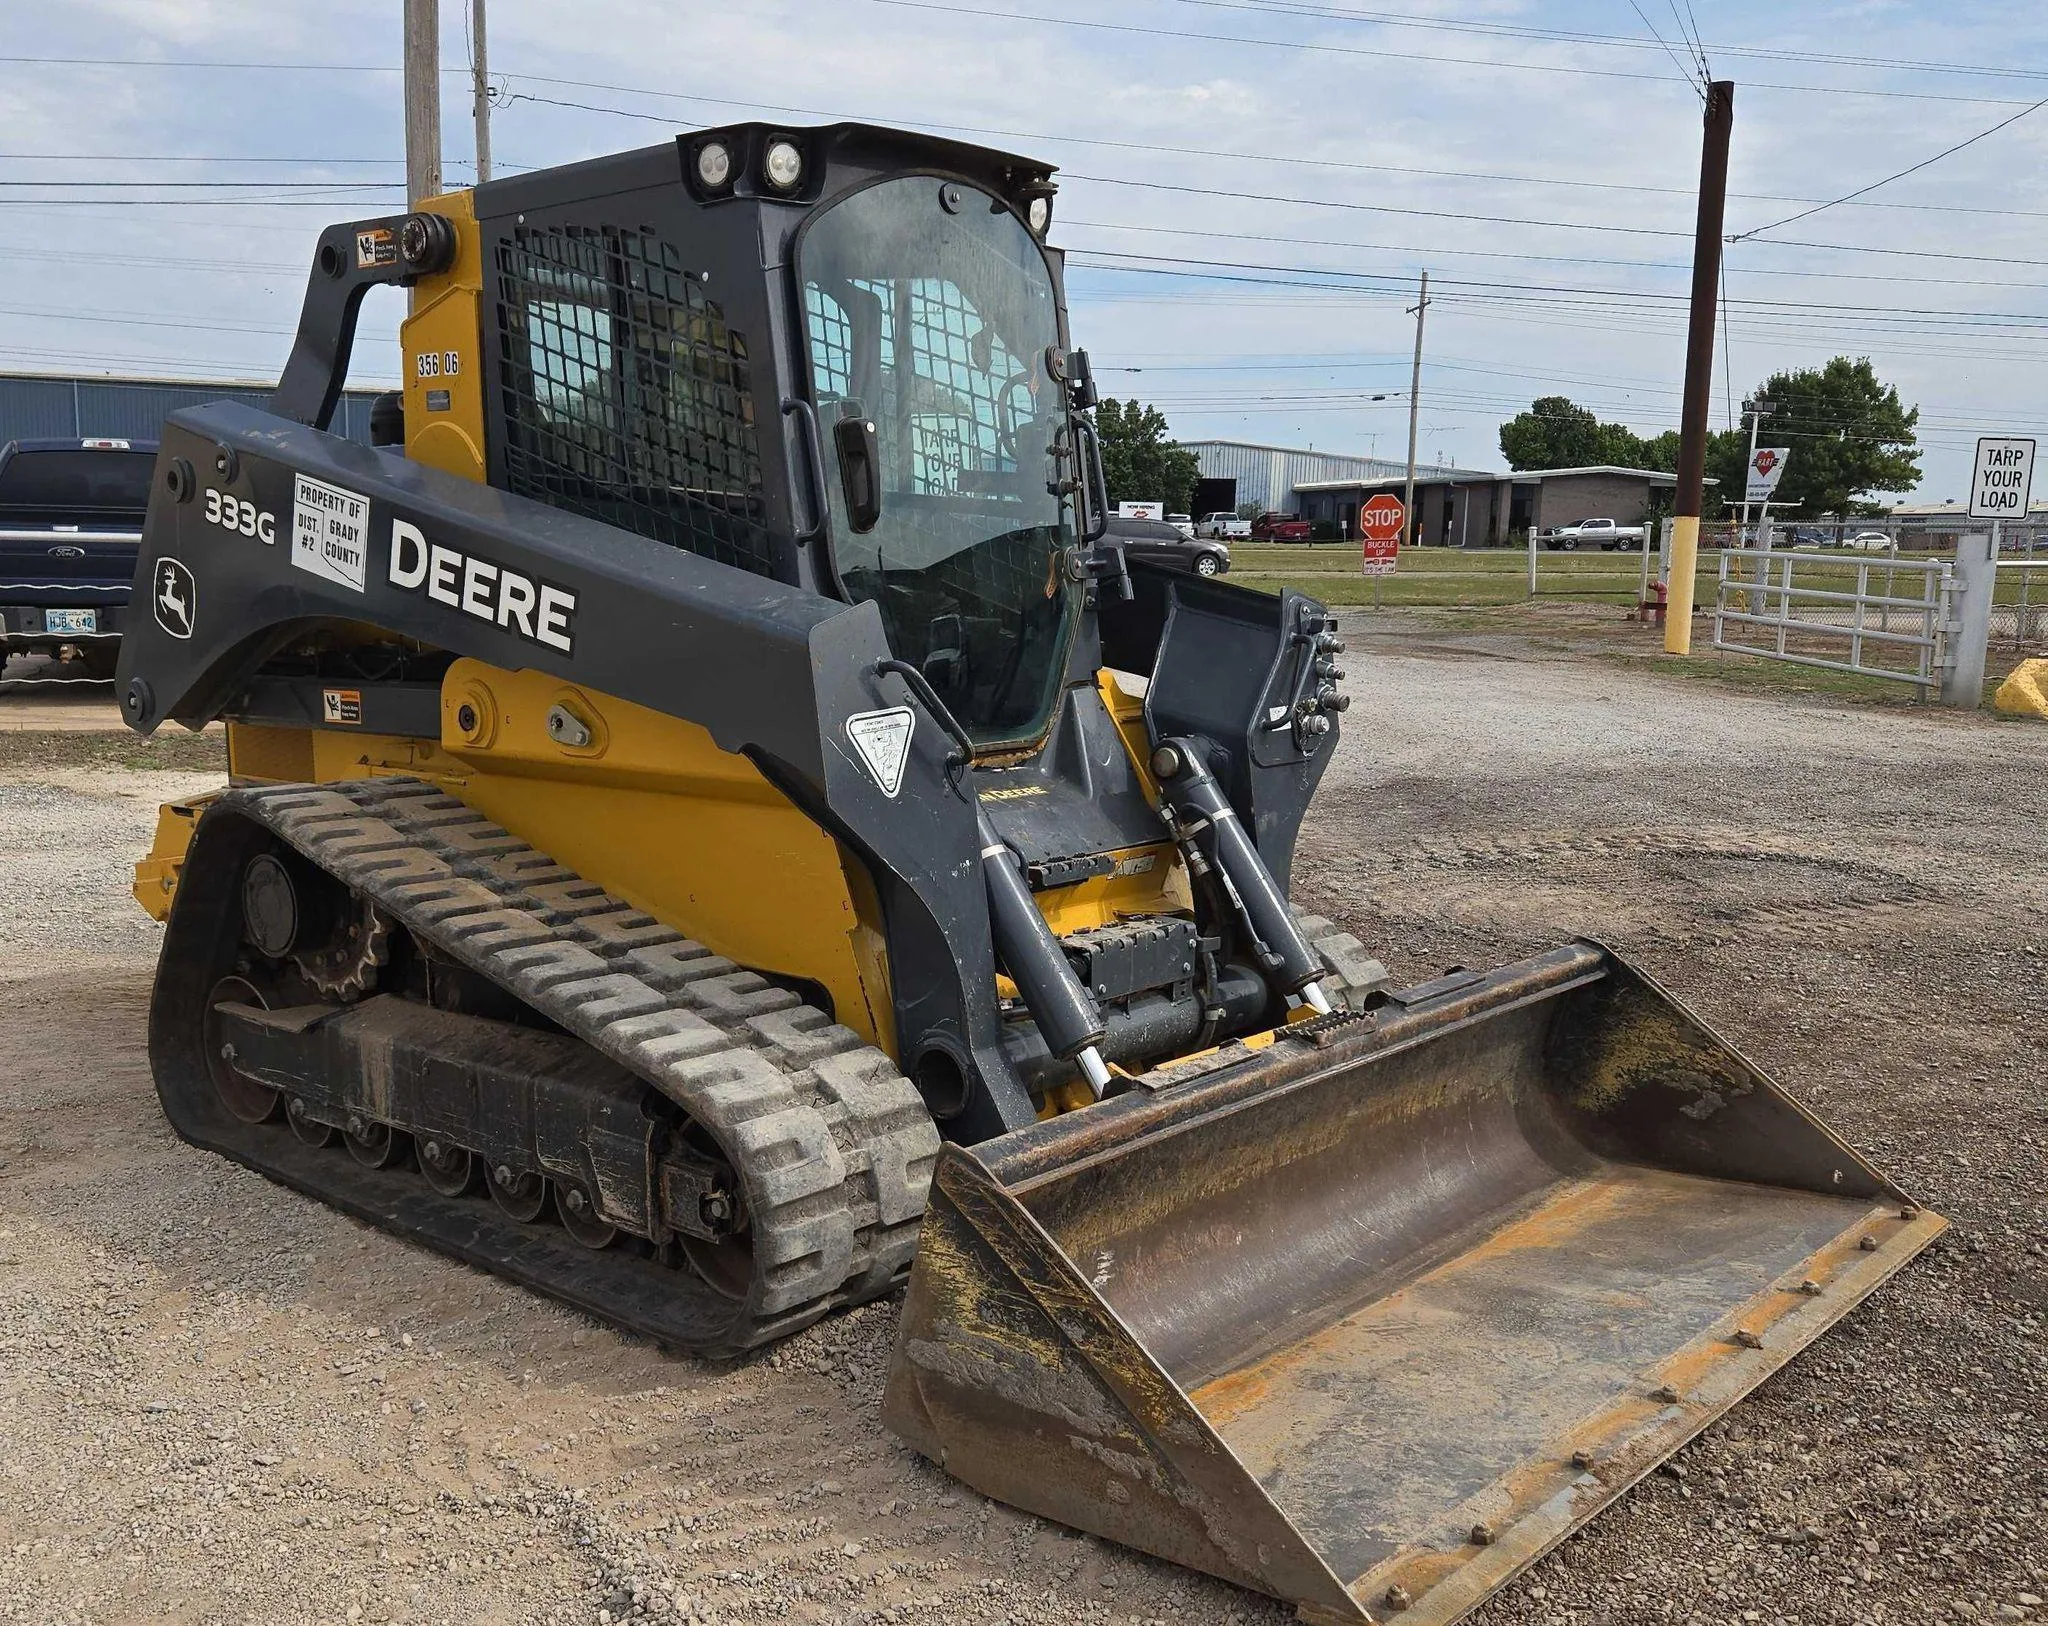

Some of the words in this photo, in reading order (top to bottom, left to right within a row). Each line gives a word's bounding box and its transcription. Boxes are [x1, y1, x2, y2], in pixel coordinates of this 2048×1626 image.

[418, 354, 439, 376] 356
[444, 352, 458, 374] 06
[1987, 449, 2024, 467] TARP
[1983, 470, 2023, 488] YOUR
[300, 484, 346, 513] PROPERTY
[348, 501, 361, 519] OF
[1980, 491, 2018, 508] LOAD
[205, 488, 276, 545] 333G
[298, 513, 320, 534] DIST.
[1364, 509, 1402, 527] STOP
[329, 519, 360, 543] GRADY
[301, 534, 315, 552] #2
[1367, 540, 1395, 549] BUCKLE
[325, 541, 361, 568] COUNTY
[389, 518, 576, 652] DEERE
[988, 786, 1049, 801] DEERE
